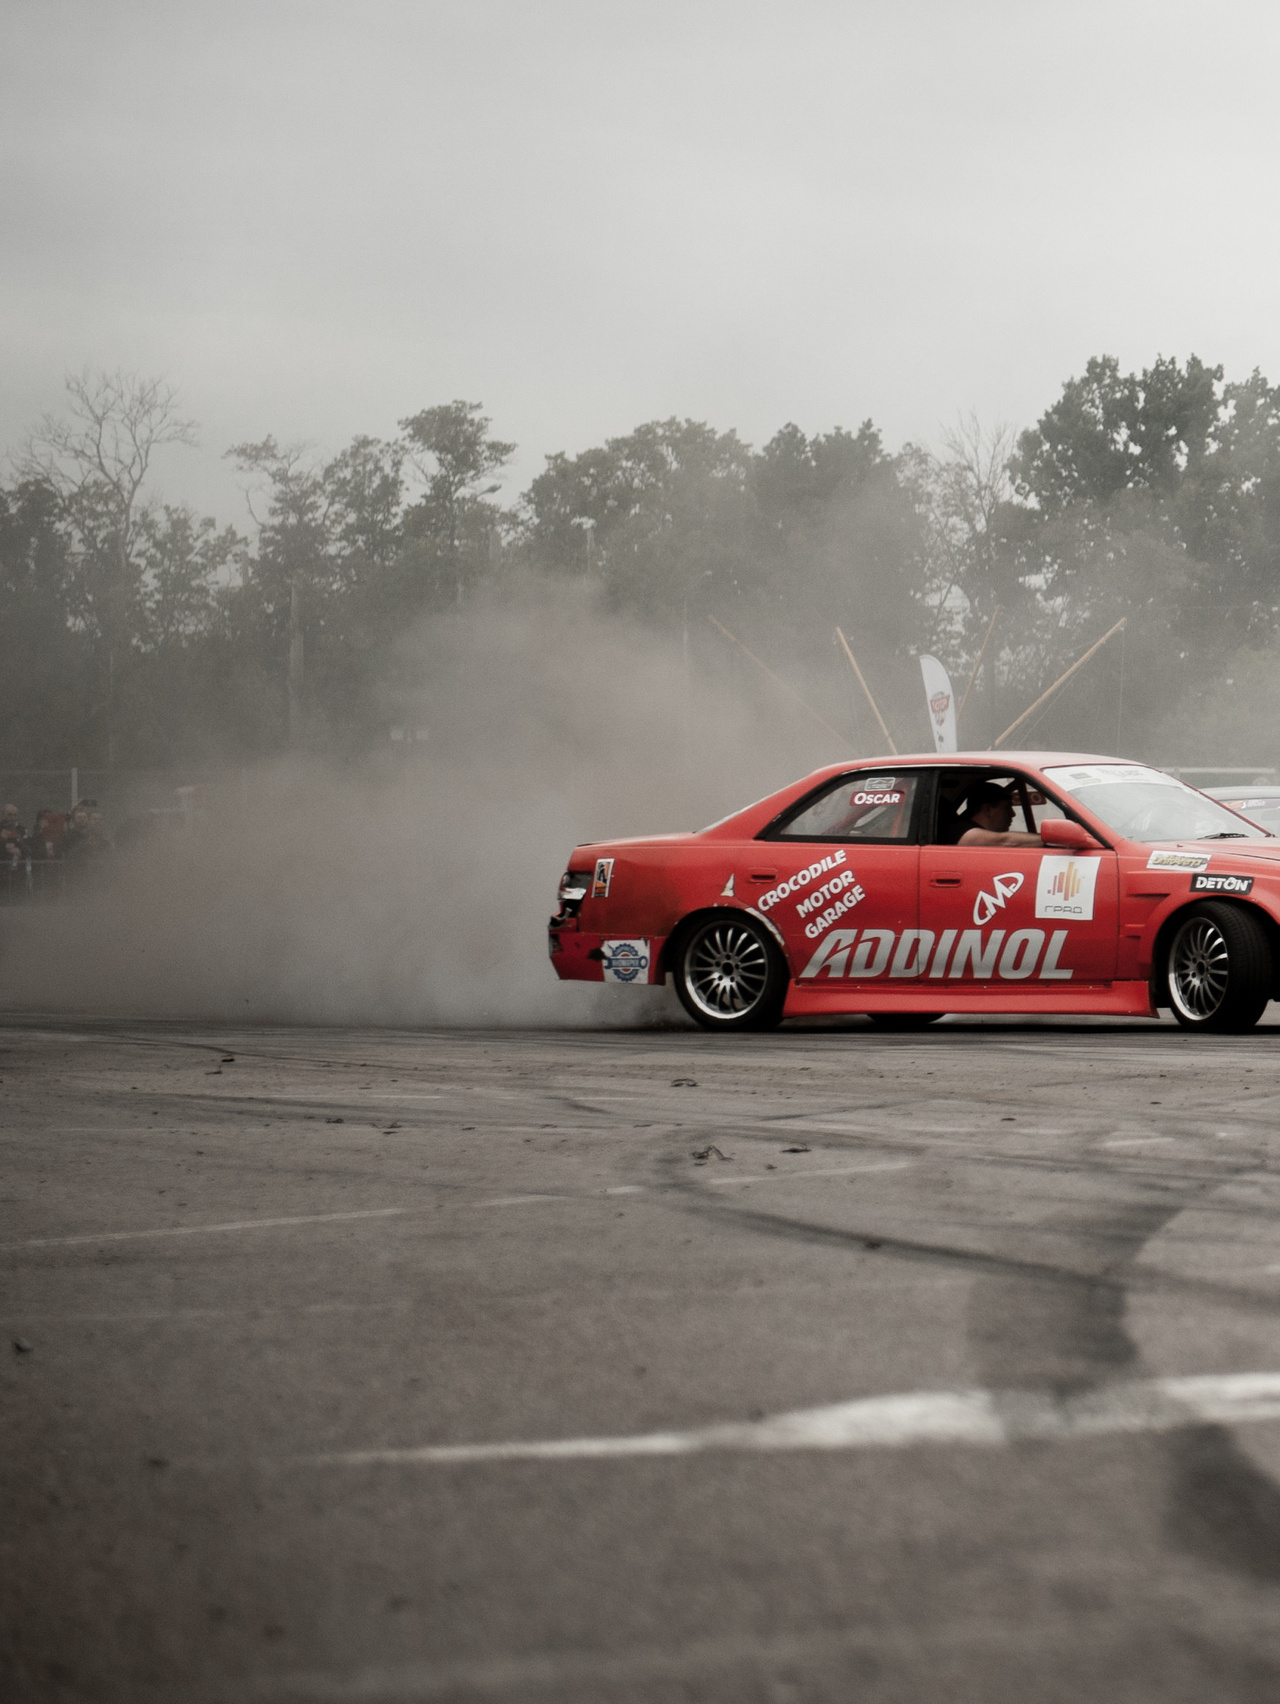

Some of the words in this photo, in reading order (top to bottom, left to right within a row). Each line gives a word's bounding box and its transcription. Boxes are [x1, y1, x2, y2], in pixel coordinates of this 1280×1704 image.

[757, 850, 847, 912] CROCODILE
[797, 870, 856, 919] MOTOR
[1195, 876, 1248, 891] DETON
[805, 885, 866, 939] GARAGE
[1044, 905, 1083, 914] ГРАД
[799, 928, 1075, 980] ADDINOL
